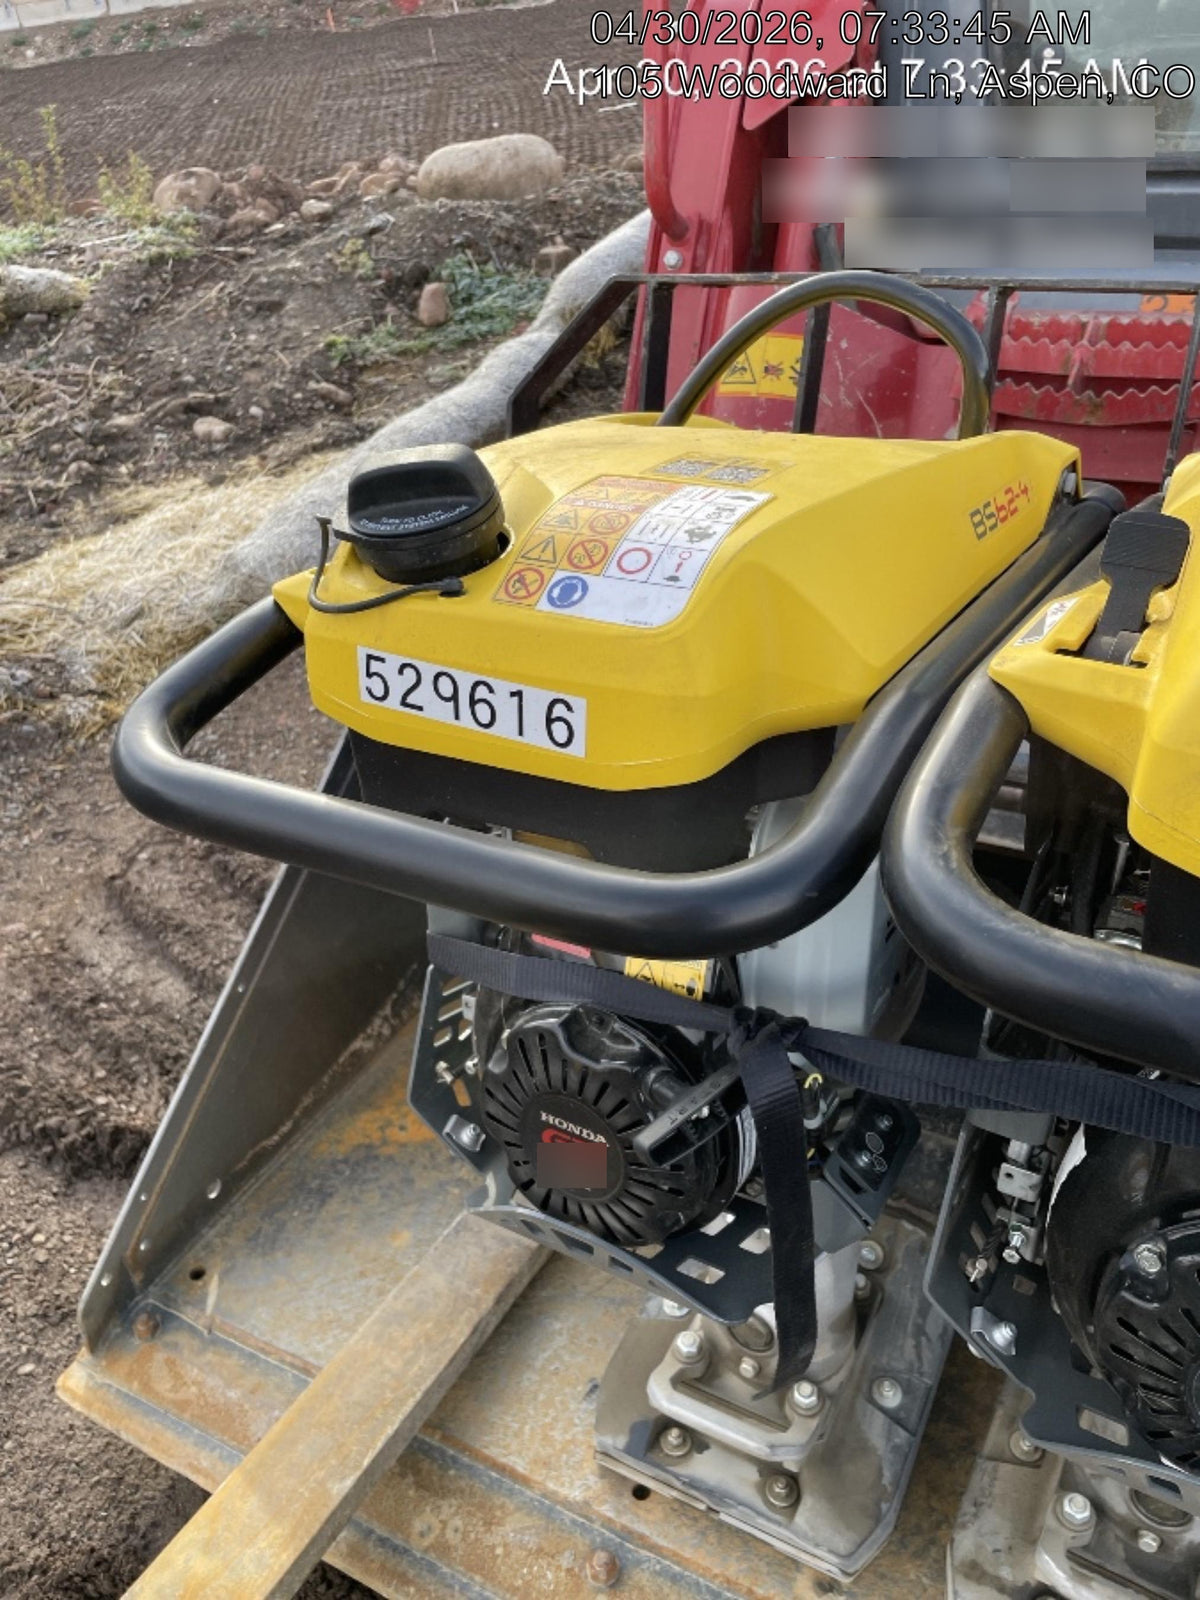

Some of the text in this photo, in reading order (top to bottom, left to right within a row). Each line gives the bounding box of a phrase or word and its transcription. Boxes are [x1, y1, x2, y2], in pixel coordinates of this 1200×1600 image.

[969, 480, 1031, 541] BS62-4
[364, 652, 576, 750] 529616
[539, 1110, 611, 1148] HONDA
